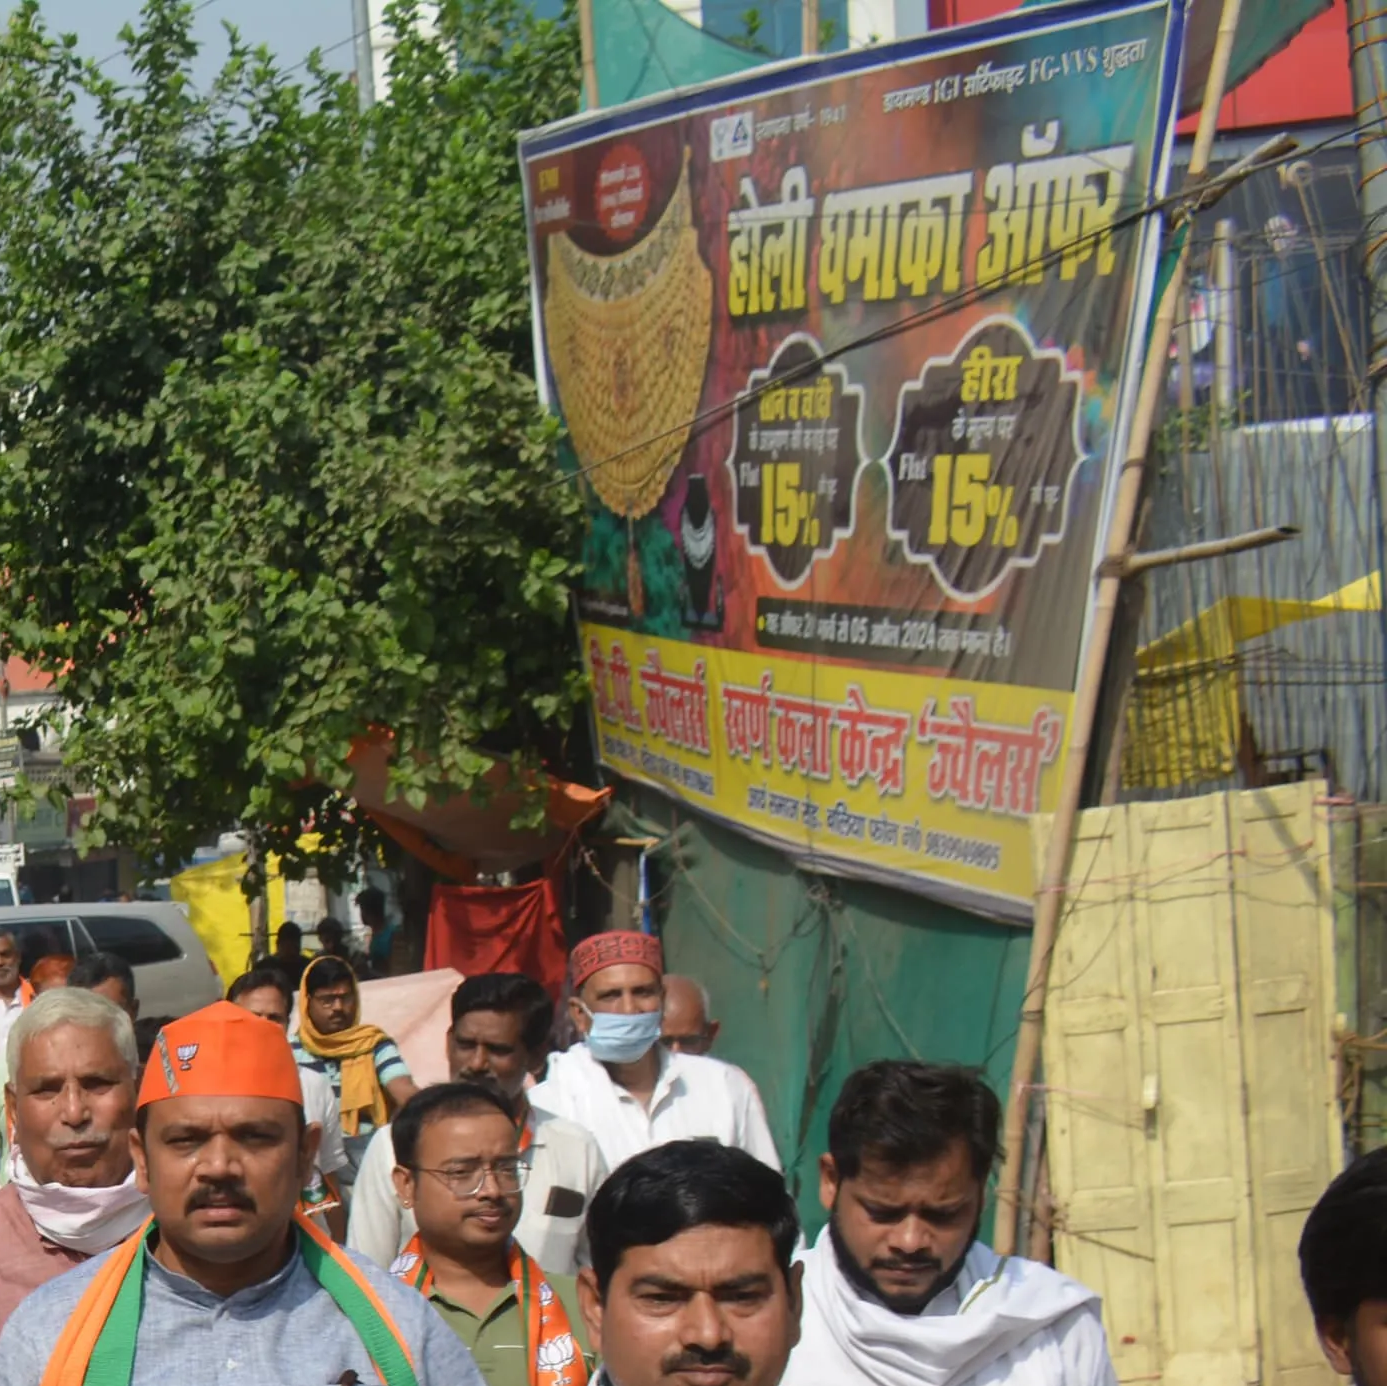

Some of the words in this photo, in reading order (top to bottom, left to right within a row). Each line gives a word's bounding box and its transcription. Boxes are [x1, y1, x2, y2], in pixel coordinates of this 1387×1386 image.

[934, 74, 961, 104] IGI
[1102, 39, 1148, 78] शुद्धता
[729, 166, 815, 316] होली
[819, 171, 975, 303] धमाका
[977, 119, 1135, 288] ऑफर
[960, 345, 1023, 402] हीरा
[761, 461, 821, 548] 15%
[898, 452, 928, 482] Flat
[928, 453, 1018, 548] 15%
[902, 622, 937, 649] 2024
[774, 693, 835, 782] कला
[836, 683, 912, 796] केन्द्र
